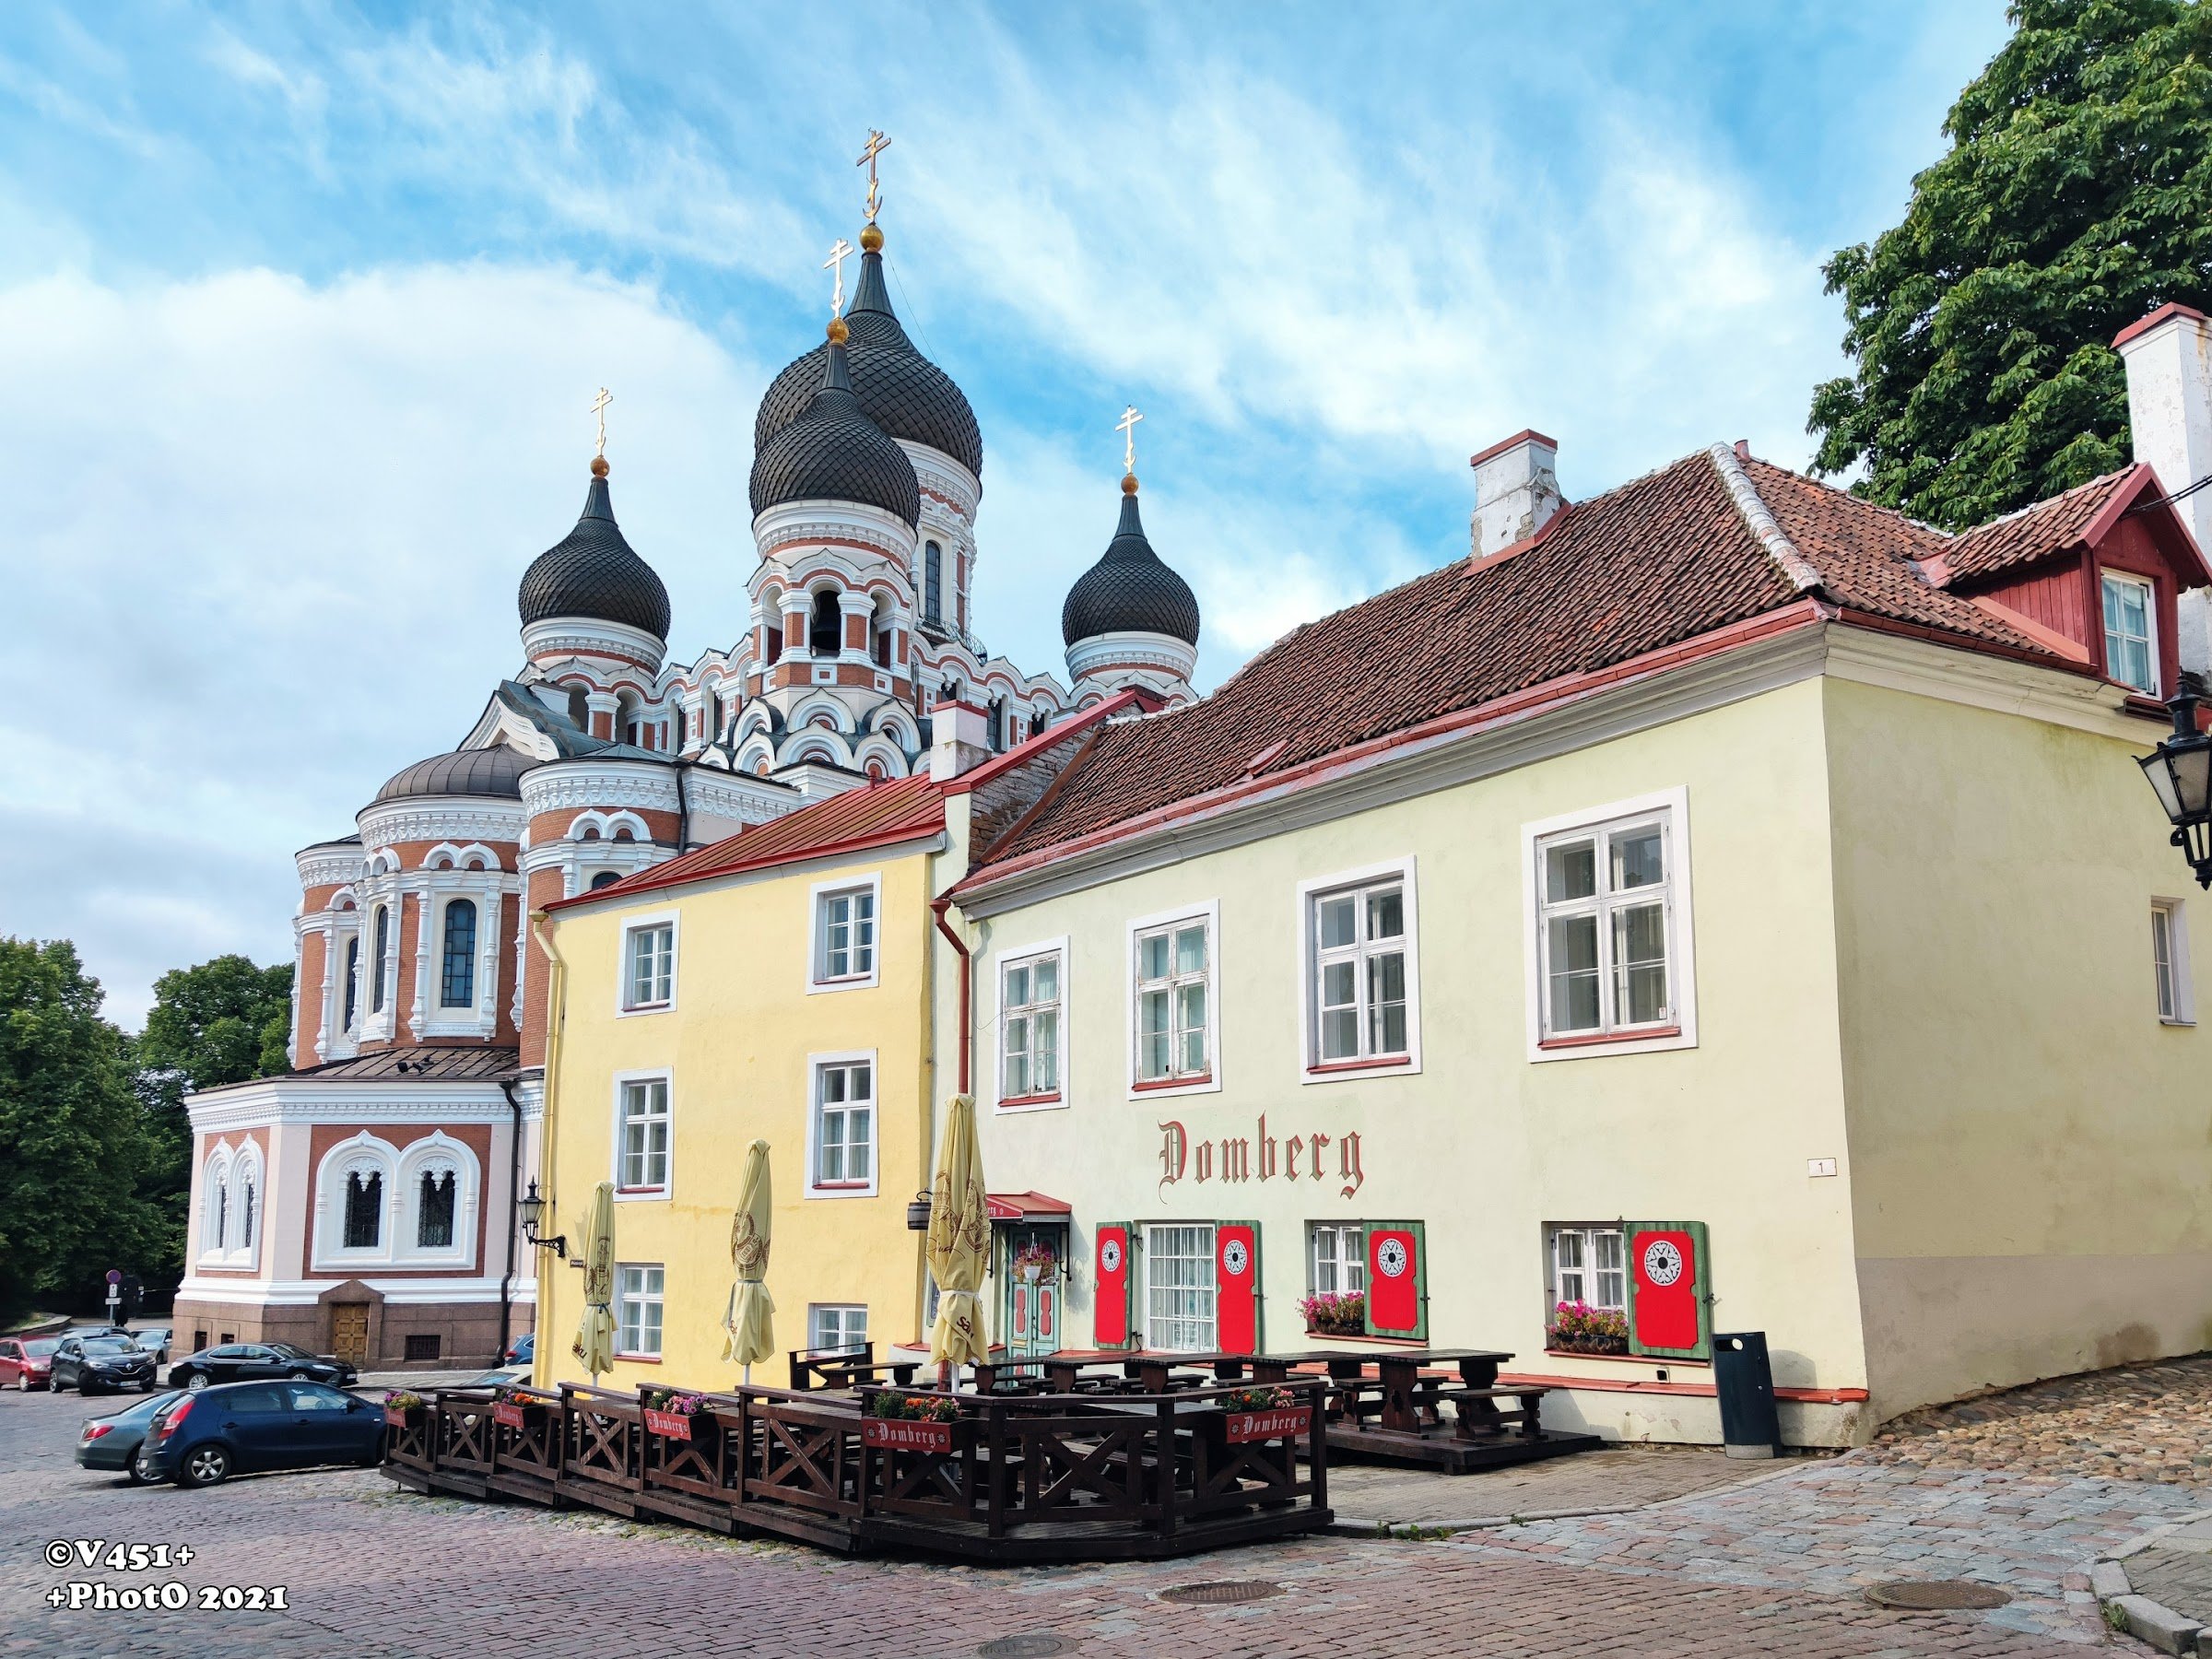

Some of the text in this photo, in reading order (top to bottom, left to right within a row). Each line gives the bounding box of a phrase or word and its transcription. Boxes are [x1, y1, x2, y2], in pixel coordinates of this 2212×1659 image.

[1158, 1110, 1364, 1205] Domberg
[1818, 1161, 1824, 1173] 1
[651, 1412, 684, 1437] Domberg
[877, 1422, 936, 1449] Domberg
[1241, 1413, 1297, 1440] Domberg
